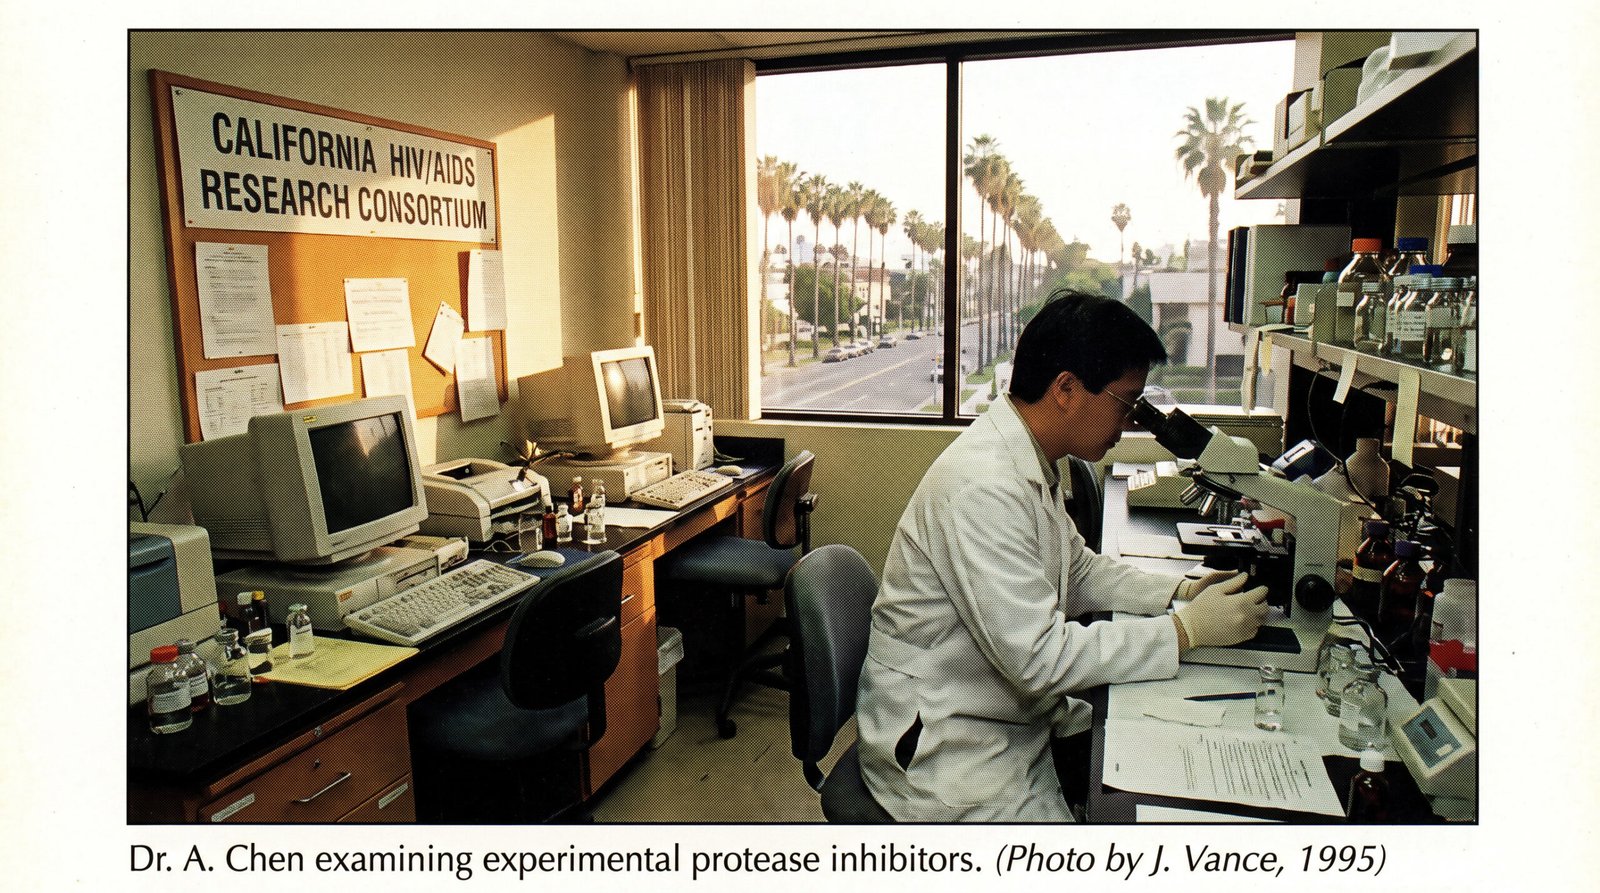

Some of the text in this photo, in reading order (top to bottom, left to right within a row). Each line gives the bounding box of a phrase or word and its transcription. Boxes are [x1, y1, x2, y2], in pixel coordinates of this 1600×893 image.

[212, 111, 476, 188] CALIFORNIA HIV/AIDS
[201, 168, 488, 230] RESEARCH CONSORTIUM
